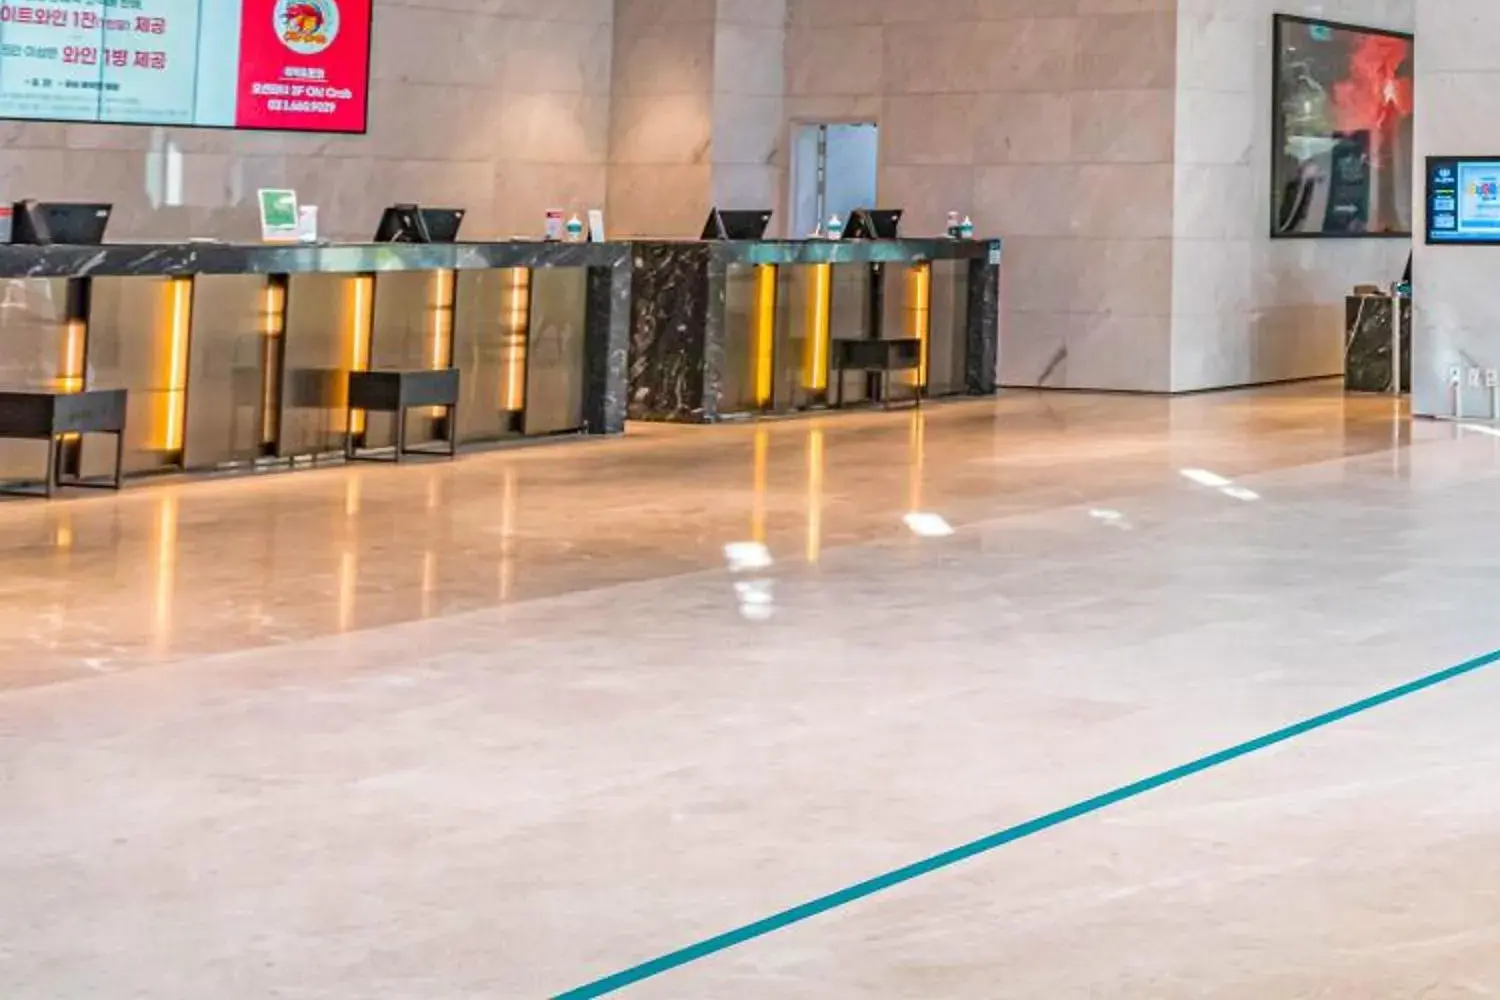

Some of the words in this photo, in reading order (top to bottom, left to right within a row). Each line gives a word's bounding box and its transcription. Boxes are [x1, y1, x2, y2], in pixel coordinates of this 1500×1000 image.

[134, 15, 166, 34] 제공
[63, 45, 97, 65] 와인
[104, 48, 128, 67] 1병
[133, 50, 166, 69] 제공
